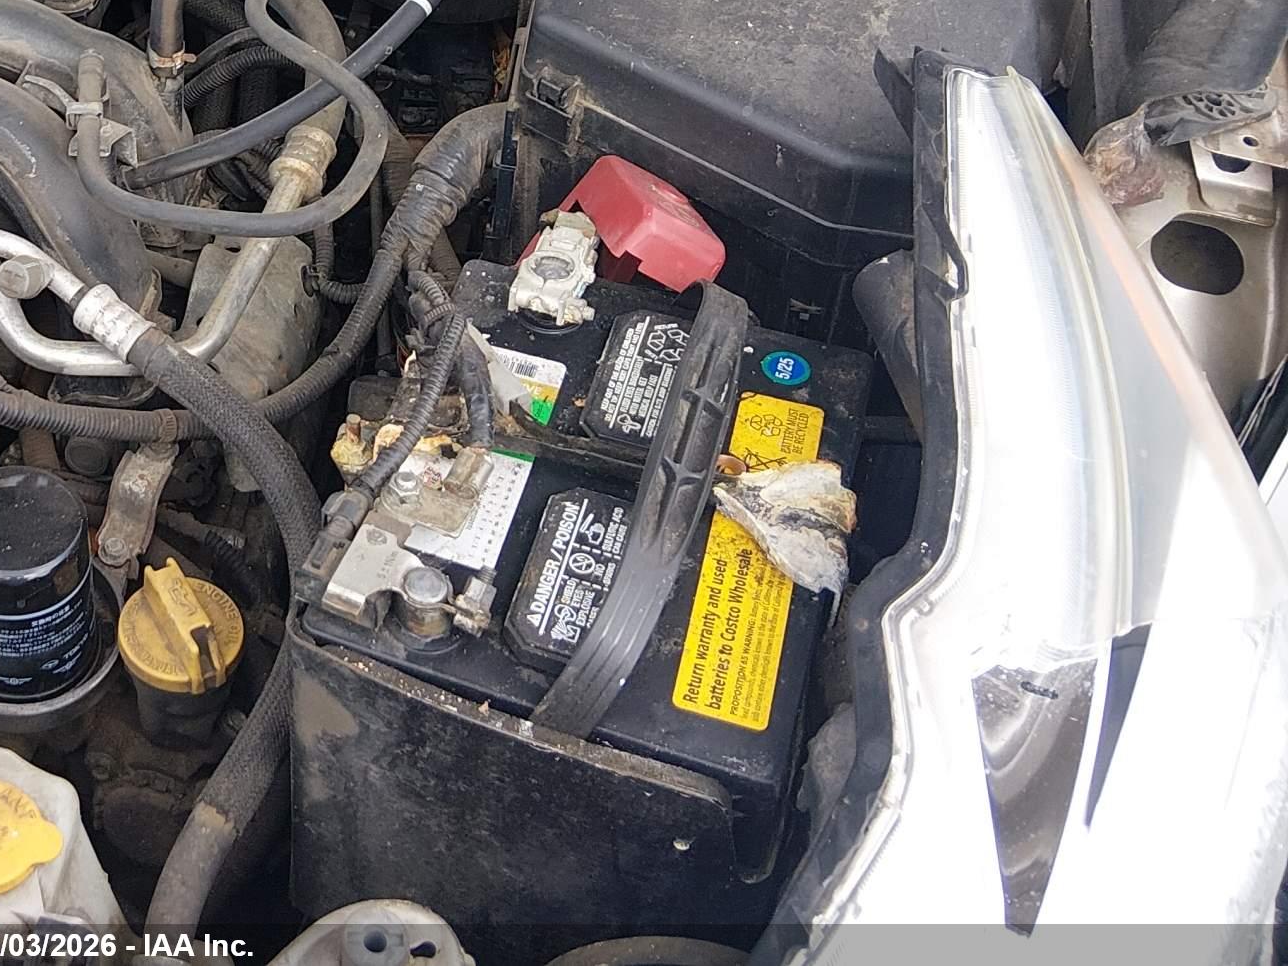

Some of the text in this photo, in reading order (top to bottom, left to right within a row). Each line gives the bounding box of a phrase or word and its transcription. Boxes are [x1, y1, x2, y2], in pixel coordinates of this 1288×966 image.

[774, 356, 794, 380] 5/25
[779, 407, 799, 453] BATTERY MUST
[791, 411, 810, 454] BE RECYCLED
[611, 505, 624, 522] ACID
[593, 562, 605, 576] NO
[194, 582, 238, 620] ENGINE
[560, 578, 576, 604] SHIELD
[570, 588, 584, 607] EYES
[575, 589, 595, 626] EXPLOSIVE
[681, 557, 729, 704] Return warranty and used
[703, 546, 757, 710] batteries to Costco Wholesale
[740, 617, 758, 655] WARNING:
[739, 655, 749, 665] 65
[727, 665, 749, 715] PROPOSITION
